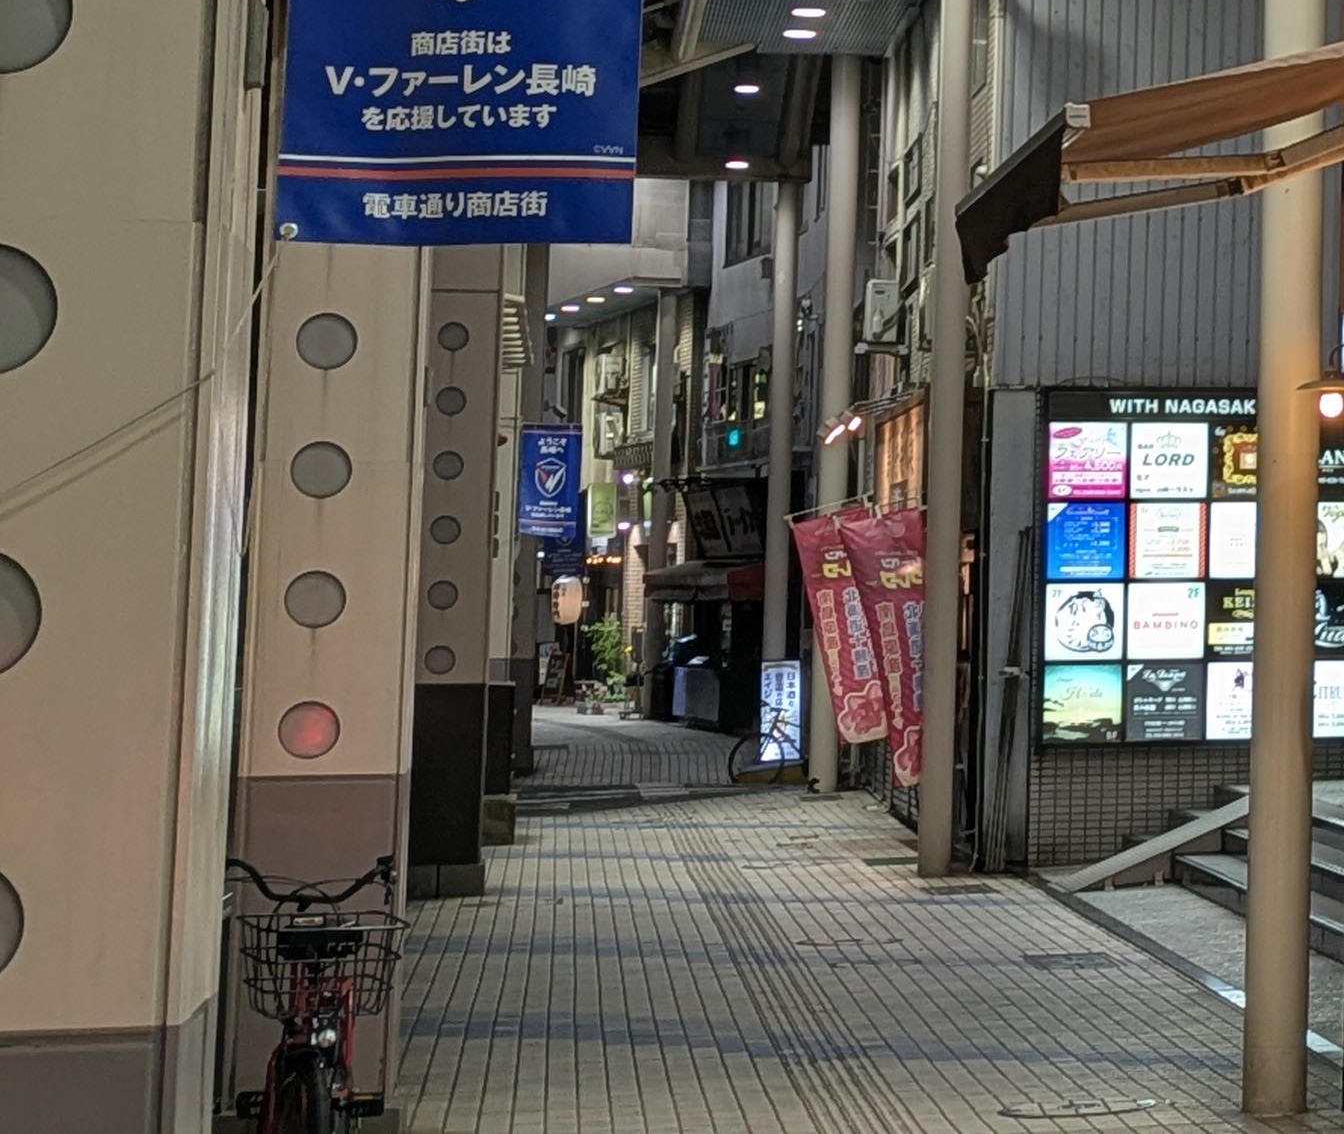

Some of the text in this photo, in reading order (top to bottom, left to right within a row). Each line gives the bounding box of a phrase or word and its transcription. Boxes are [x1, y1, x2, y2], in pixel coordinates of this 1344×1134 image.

[411, 31, 511, 57] 商店街は
[361, 104, 557, 131] を応援しています
[362, 190, 548, 219] 電車通り商店街
[1109, 399, 1257, 415] WITH NAGASAK
[1142, 453, 1195, 467] LORD
[1188, 588, 1200, 599] 2F
[1133, 620, 1198, 630] BAMBINO
